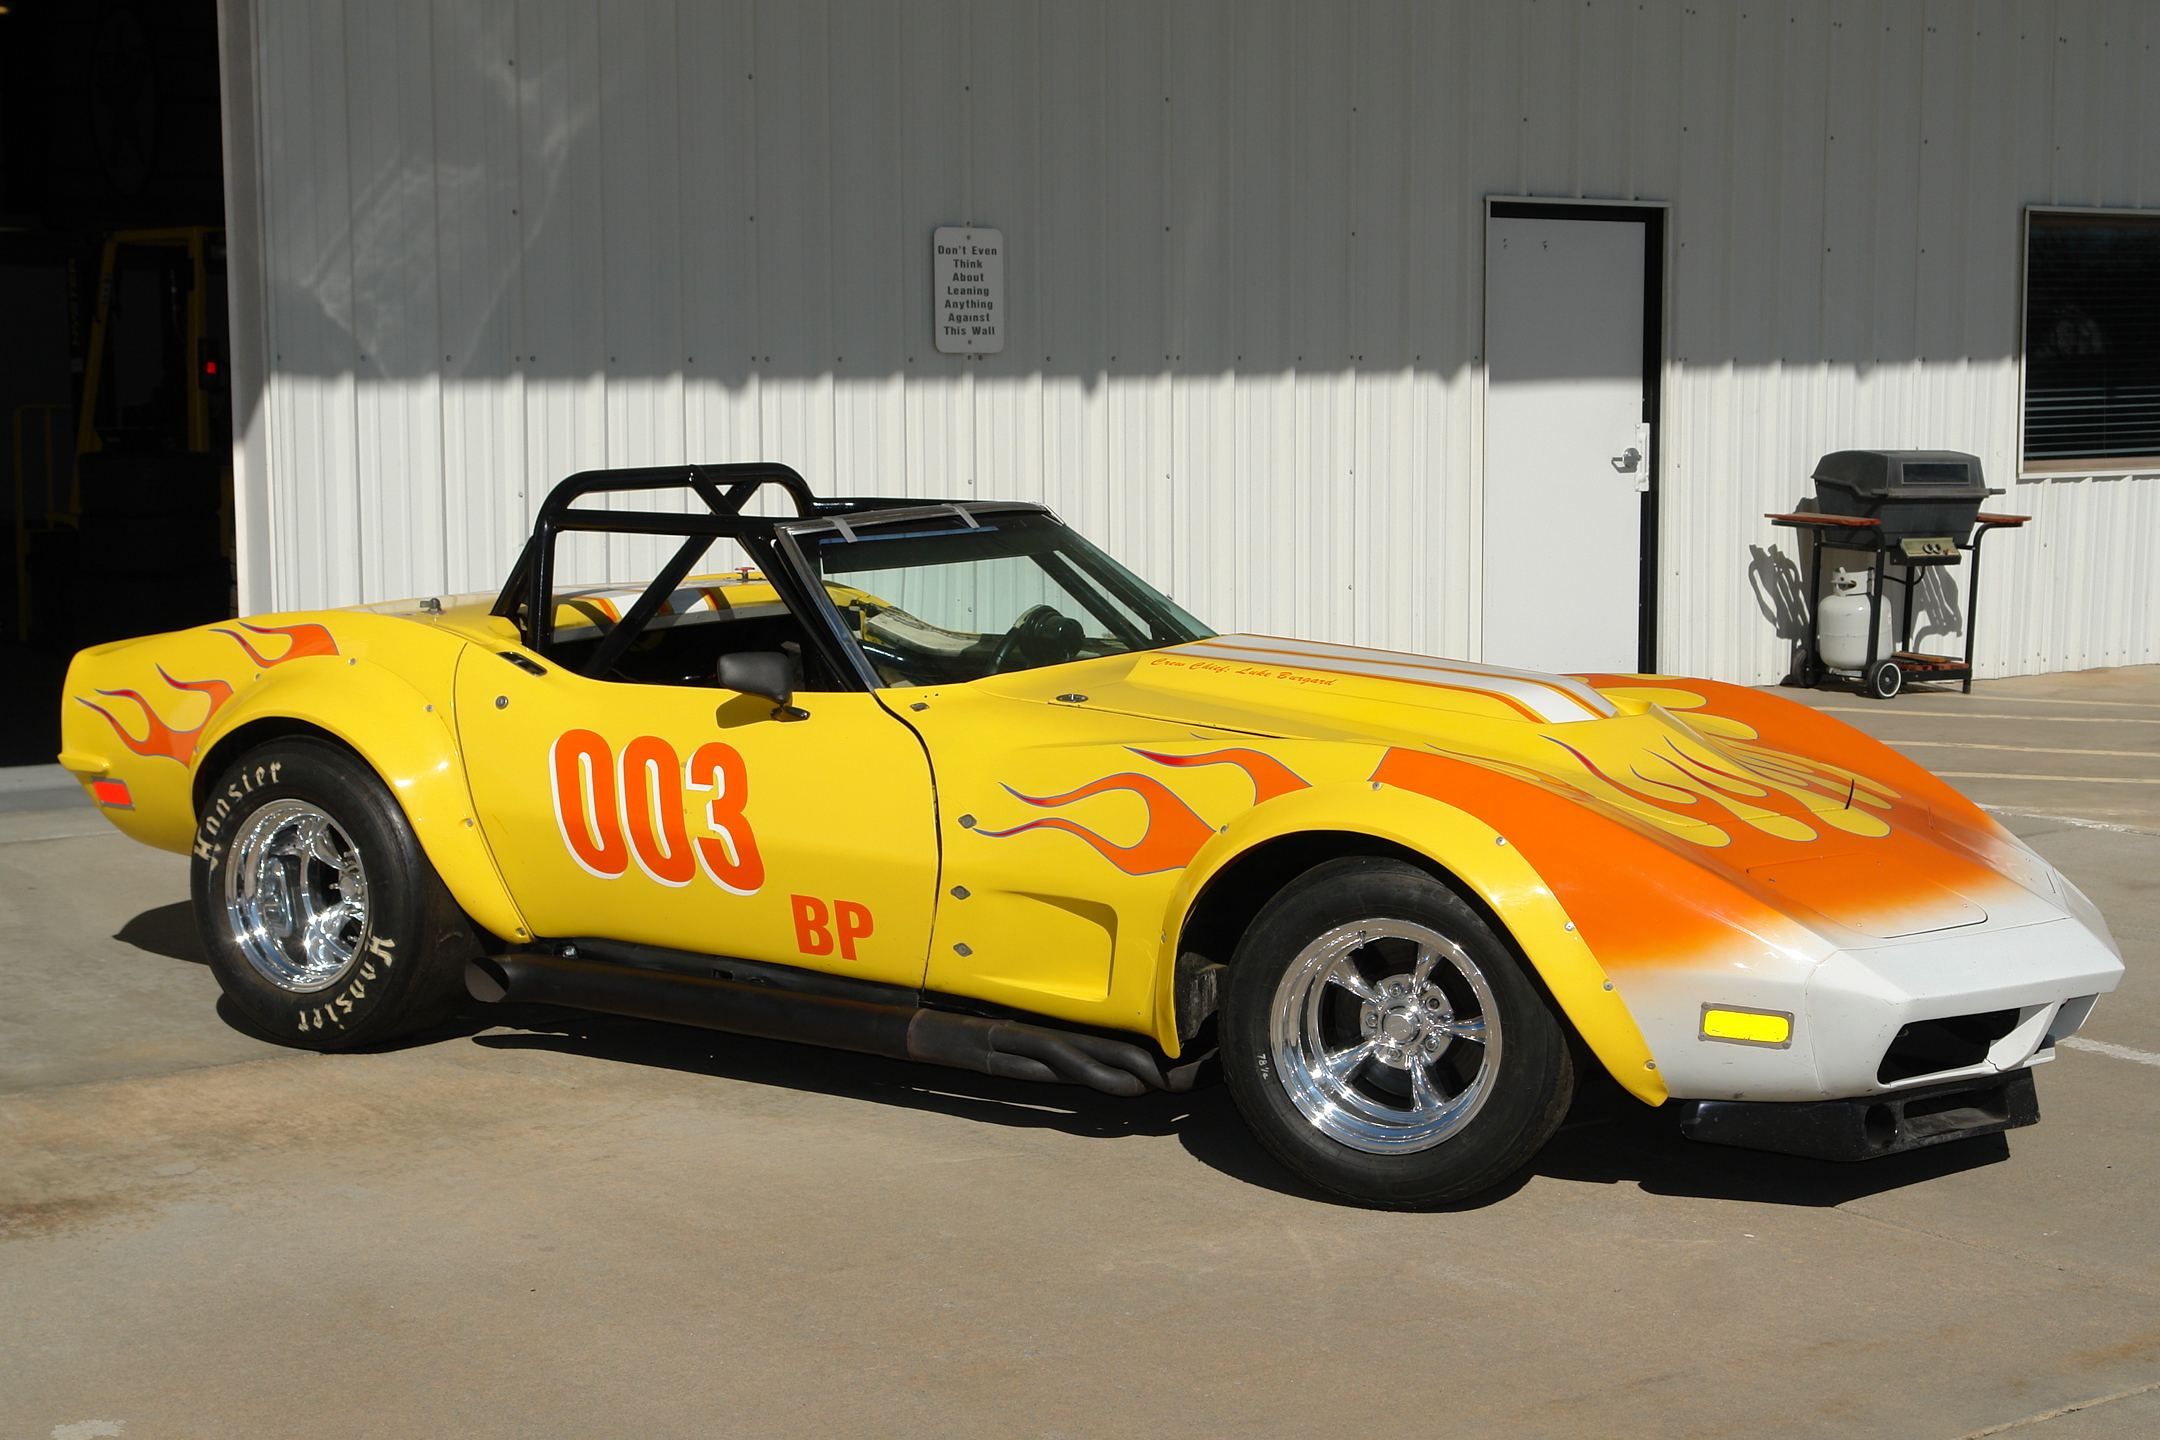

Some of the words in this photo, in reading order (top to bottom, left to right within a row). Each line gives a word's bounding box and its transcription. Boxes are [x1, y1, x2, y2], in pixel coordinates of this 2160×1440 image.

[937, 245, 967, 255] Don't
[971, 245, 998, 256] Even
[952, 259, 983, 269] Think
[952, 272, 985, 282] About
[947, 286, 990, 297] Leaning
[944, 299, 994, 310] Anything
[948, 313, 990, 323] Against
[943, 326, 967, 336] This
[971, 326, 996, 336] Wall
[1150, 657, 1186, 667] Crew
[1188, 661, 1231, 674] Chief:
[1234, 667, 1272, 678] Luke
[1276, 671, 1338, 686] Burgard
[194, 761, 281, 871] Hoosier
[548, 728, 766, 897] 003
[790, 893, 875, 962] BP
[297, 934, 396, 1032] Hoosier
